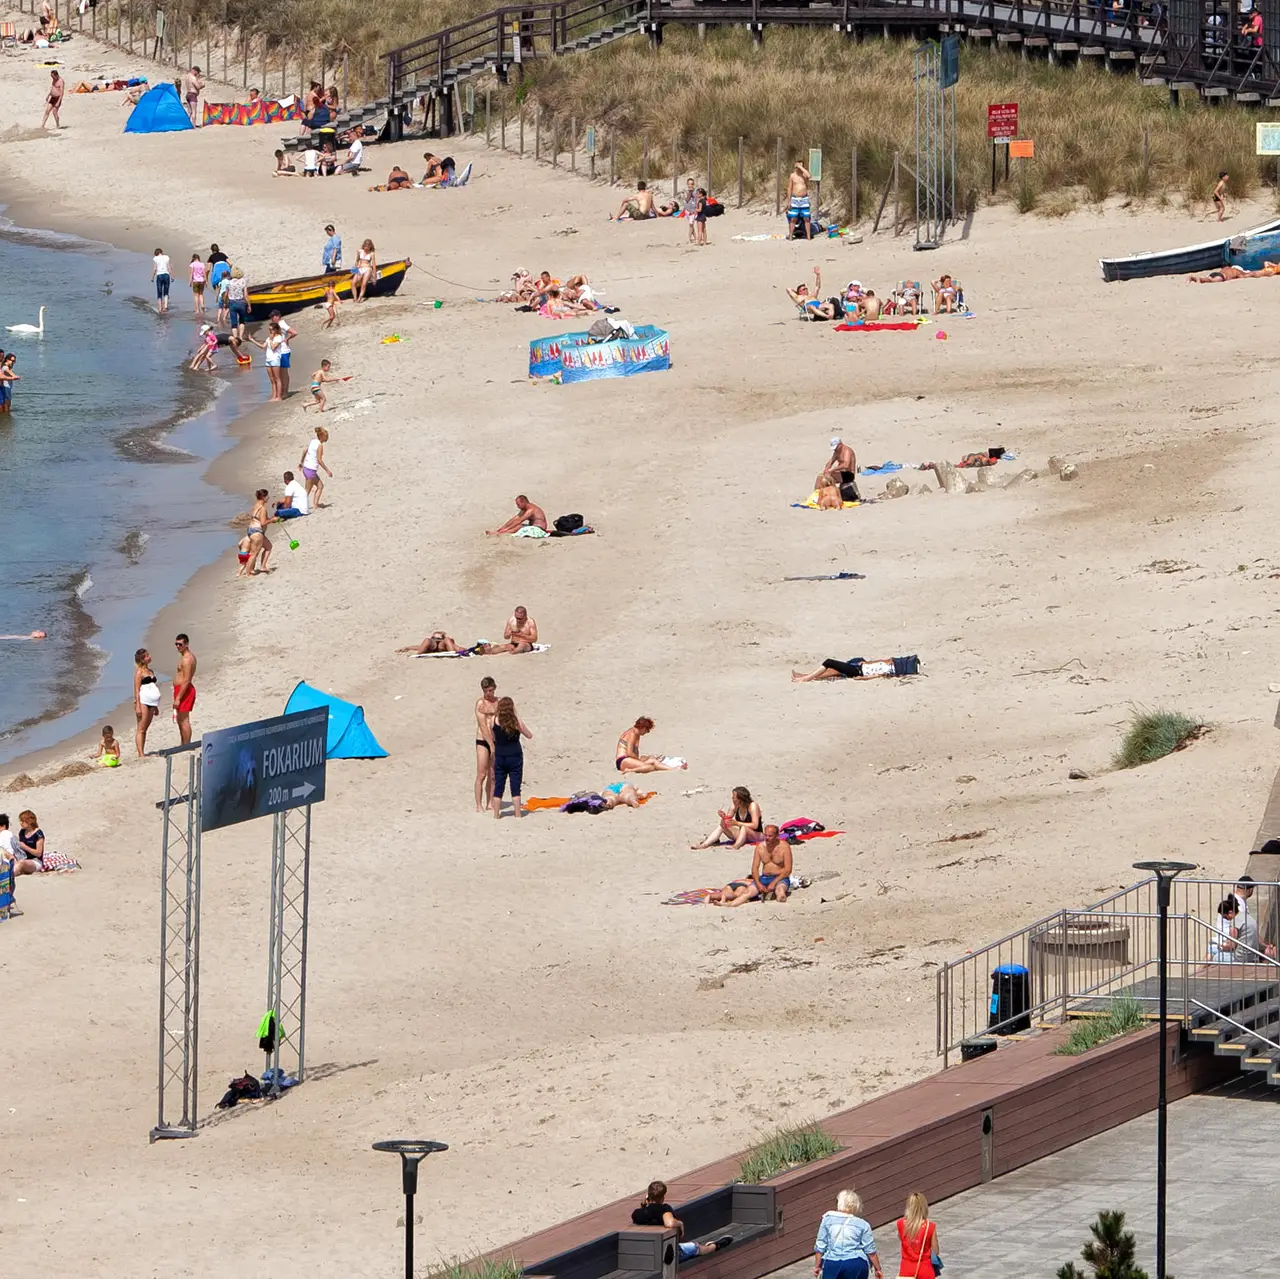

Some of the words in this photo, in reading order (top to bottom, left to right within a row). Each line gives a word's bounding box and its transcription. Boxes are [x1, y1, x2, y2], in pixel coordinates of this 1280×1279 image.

[262, 737, 323, 778] FOKARIUM
[268, 786, 282, 805] 200
[282, 789, 289, 802] m
